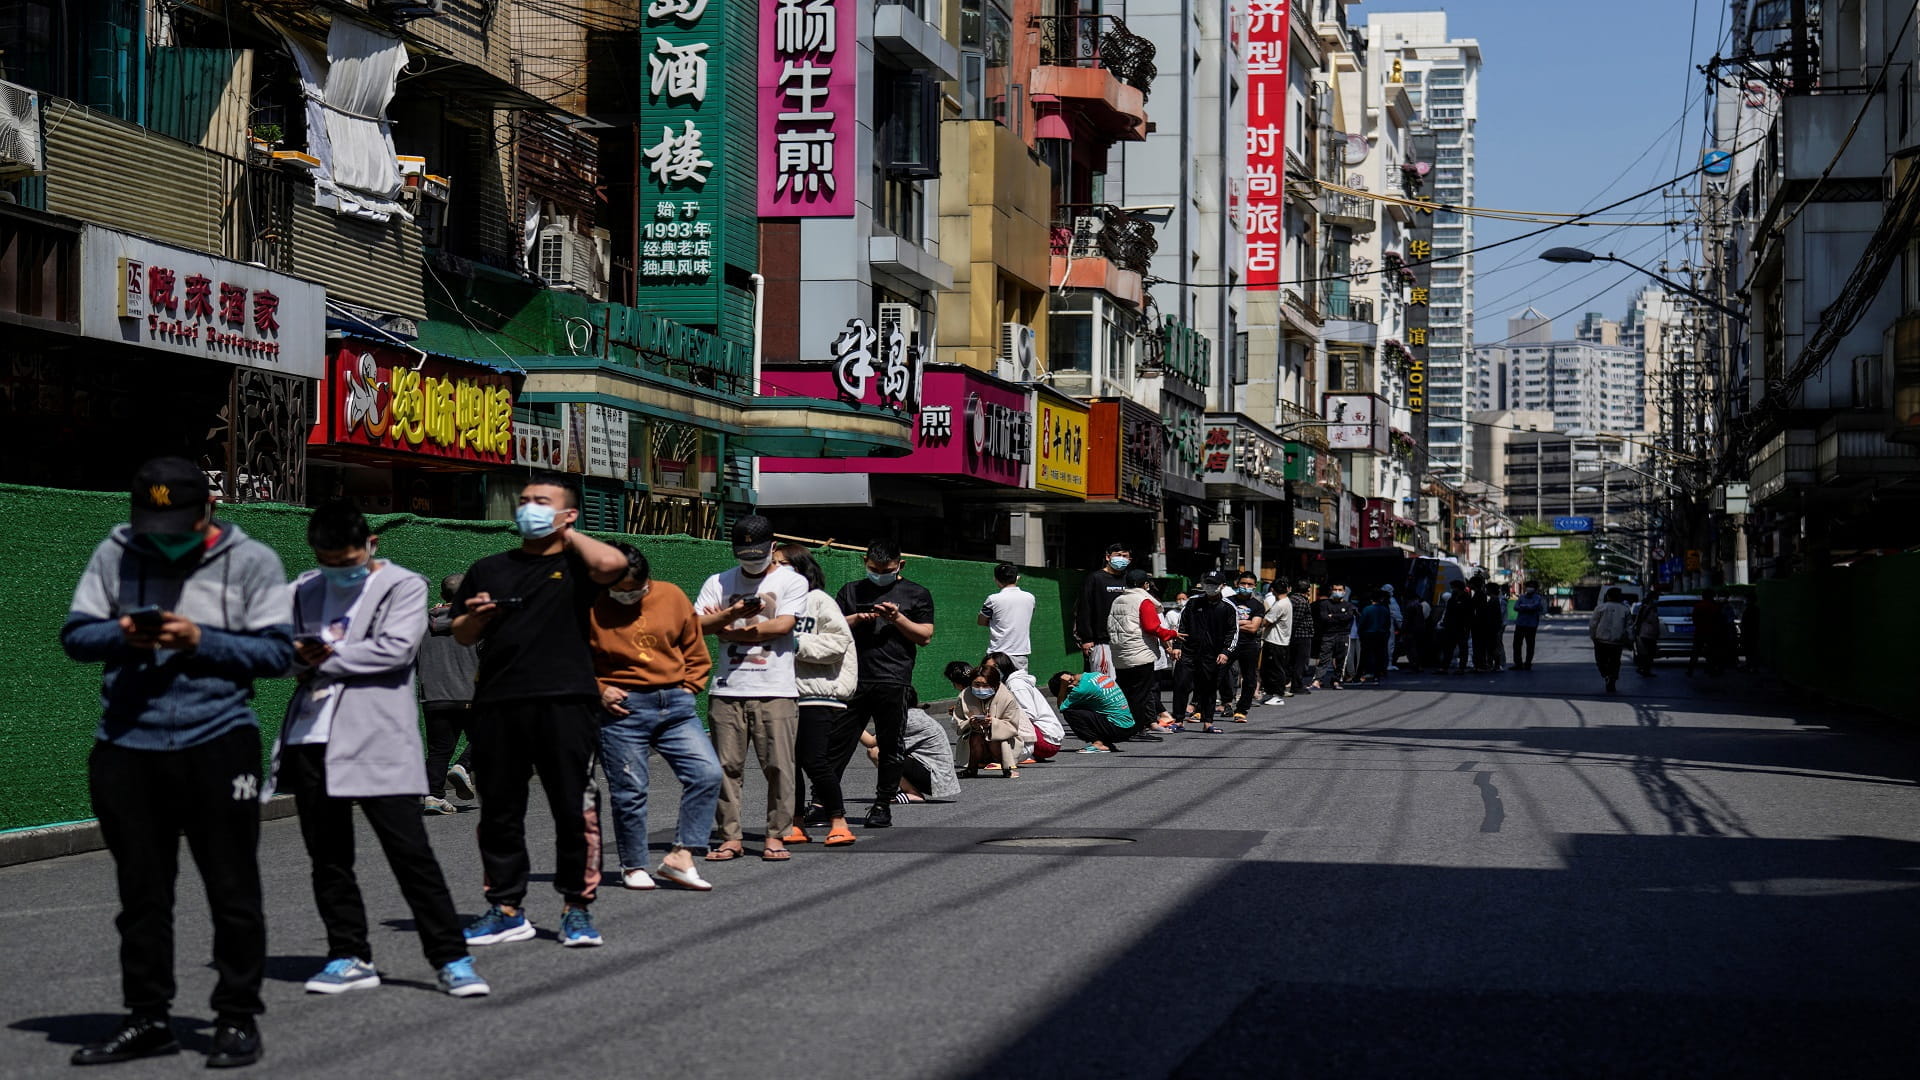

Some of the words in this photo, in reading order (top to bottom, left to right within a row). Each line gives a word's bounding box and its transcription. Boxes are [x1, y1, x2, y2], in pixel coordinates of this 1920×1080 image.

[777, 0, 836, 193] 杨生煎
[657, 201, 701, 218] 始于
[644, 222, 712, 239] 1993年
[643, 241, 712, 257] 经典老店
[643, 260, 712, 276] 独具风味
[206, 326, 280, 354] Restaurant
[832, 318, 928, 411] 半岛
[1408, 360, 1424, 416] HOTEL
[391, 365, 512, 456] 绝味鸭脖
[921, 405, 953, 437] 煎
[1205, 427, 1231, 471] 旅店
[232, 772, 259, 800] NY
